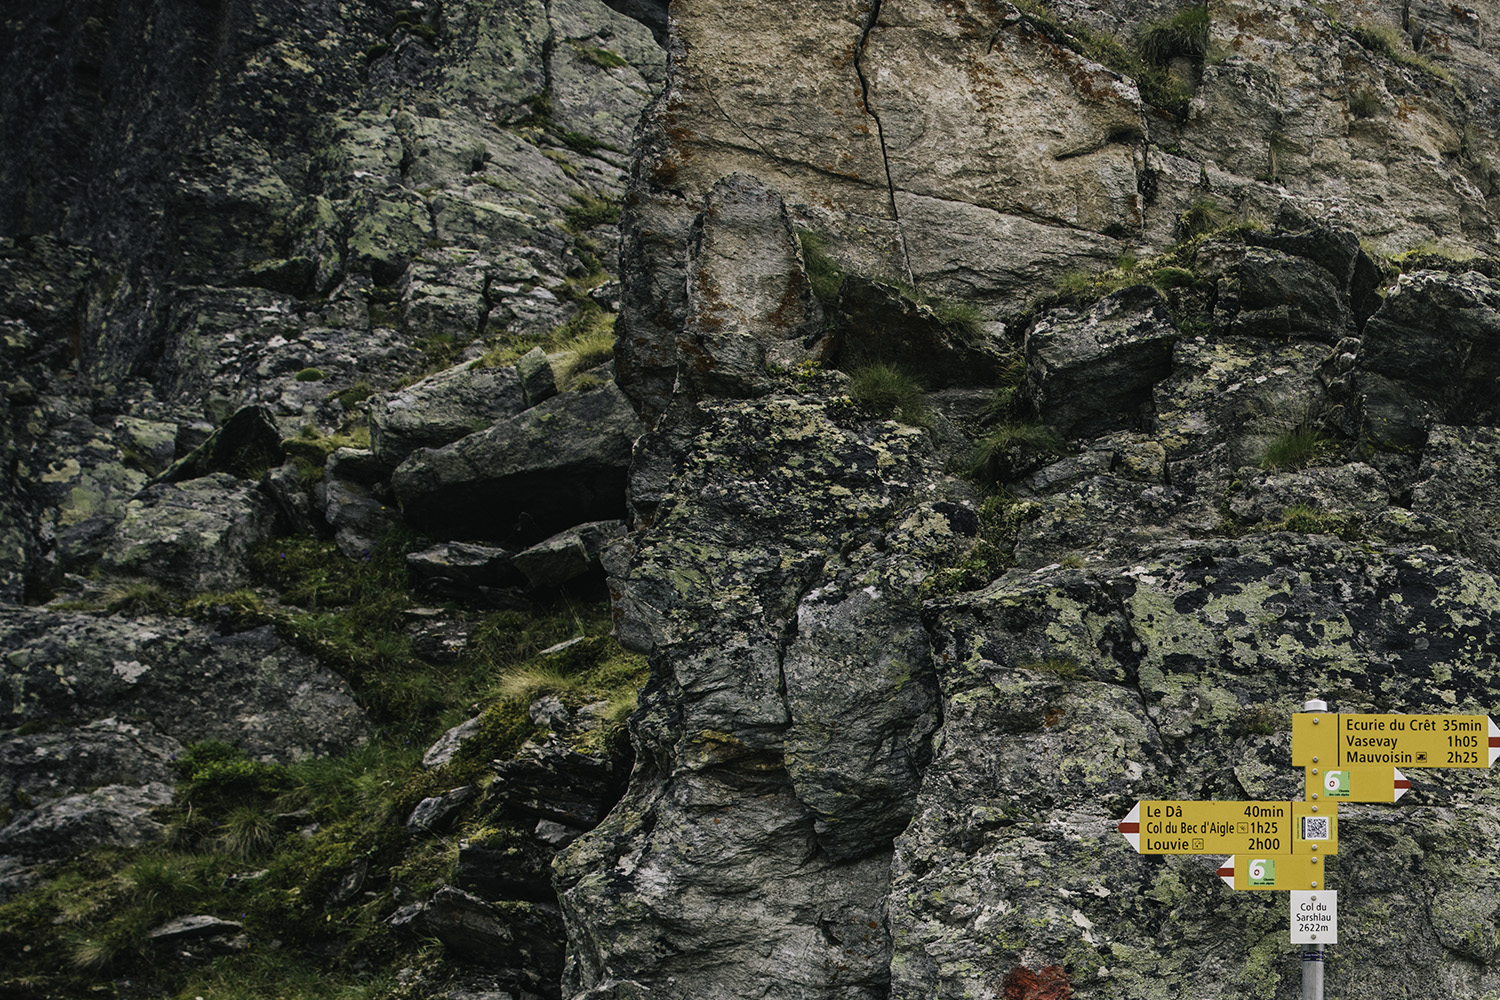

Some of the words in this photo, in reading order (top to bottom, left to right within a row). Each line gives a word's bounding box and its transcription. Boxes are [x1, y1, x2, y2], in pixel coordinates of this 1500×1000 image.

[1347, 719, 1385, 731] Ecurie
[1389, 719, 1405, 731] du
[1410, 719, 1436, 731] Crêt
[1443, 720, 1482, 731] 35min
[1346, 735, 1398, 749] Vasevay
[1448, 736, 1478, 747] 1h05
[1347, 751, 1412, 763] Mauvoisin
[1447, 752, 1478, 763] 2h25
[1325, 771, 1342, 791] 6
[1147, 806, 1161, 817] Le
[1166, 806, 1182, 817] Dâ
[1244, 806, 1284, 817] 40min
[1147, 822, 1162, 834] Col
[1165, 822, 1177, 834] du
[1181, 822, 1197, 834] Bec
[1201, 822, 1235, 836] d'Aigle
[1251, 822, 1278, 833] 1h25
[1147, 838, 1189, 850] Louvie
[1248, 838, 1280, 850] 2h00
[1249, 859, 1266, 879] 6
[1300, 903, 1314, 911] Col
[1316, 903, 1327, 911] du
[1296, 913, 1331, 921] Sarshlau
[1299, 924, 1329, 932] 2622m
